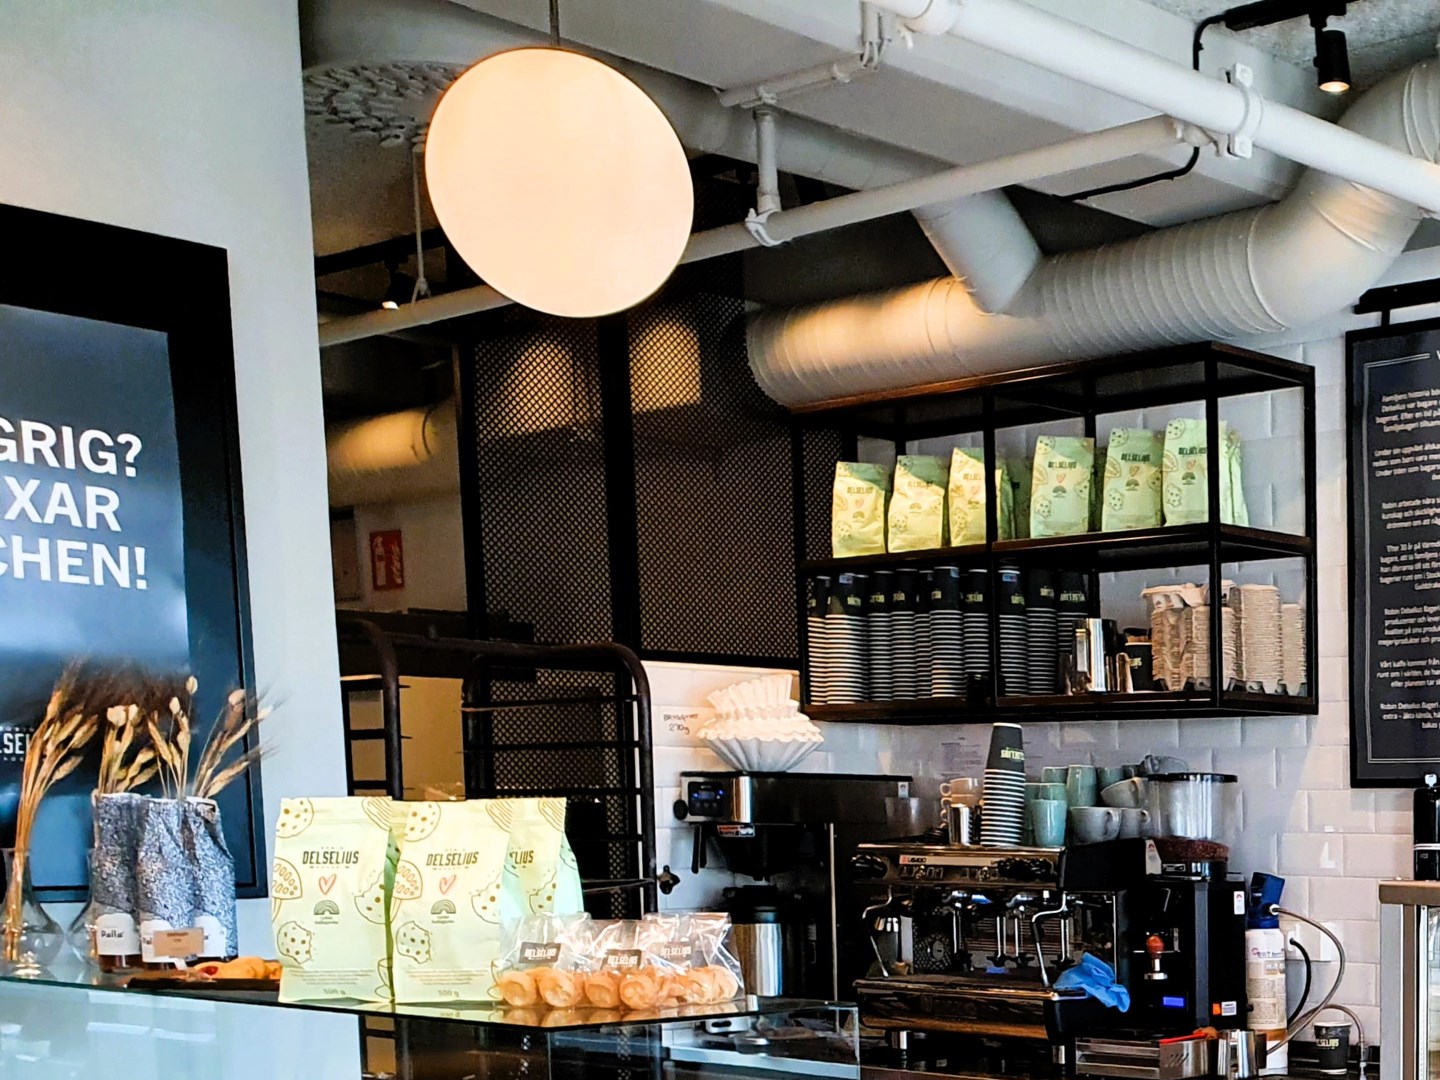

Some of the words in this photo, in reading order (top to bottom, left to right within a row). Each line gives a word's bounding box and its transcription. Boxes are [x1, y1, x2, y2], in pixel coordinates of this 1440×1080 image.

[3, 476, 122, 532] XAR
[302, 851, 359, 865] DELSELIUS
[426, 852, 479, 866] DELSELIUS
